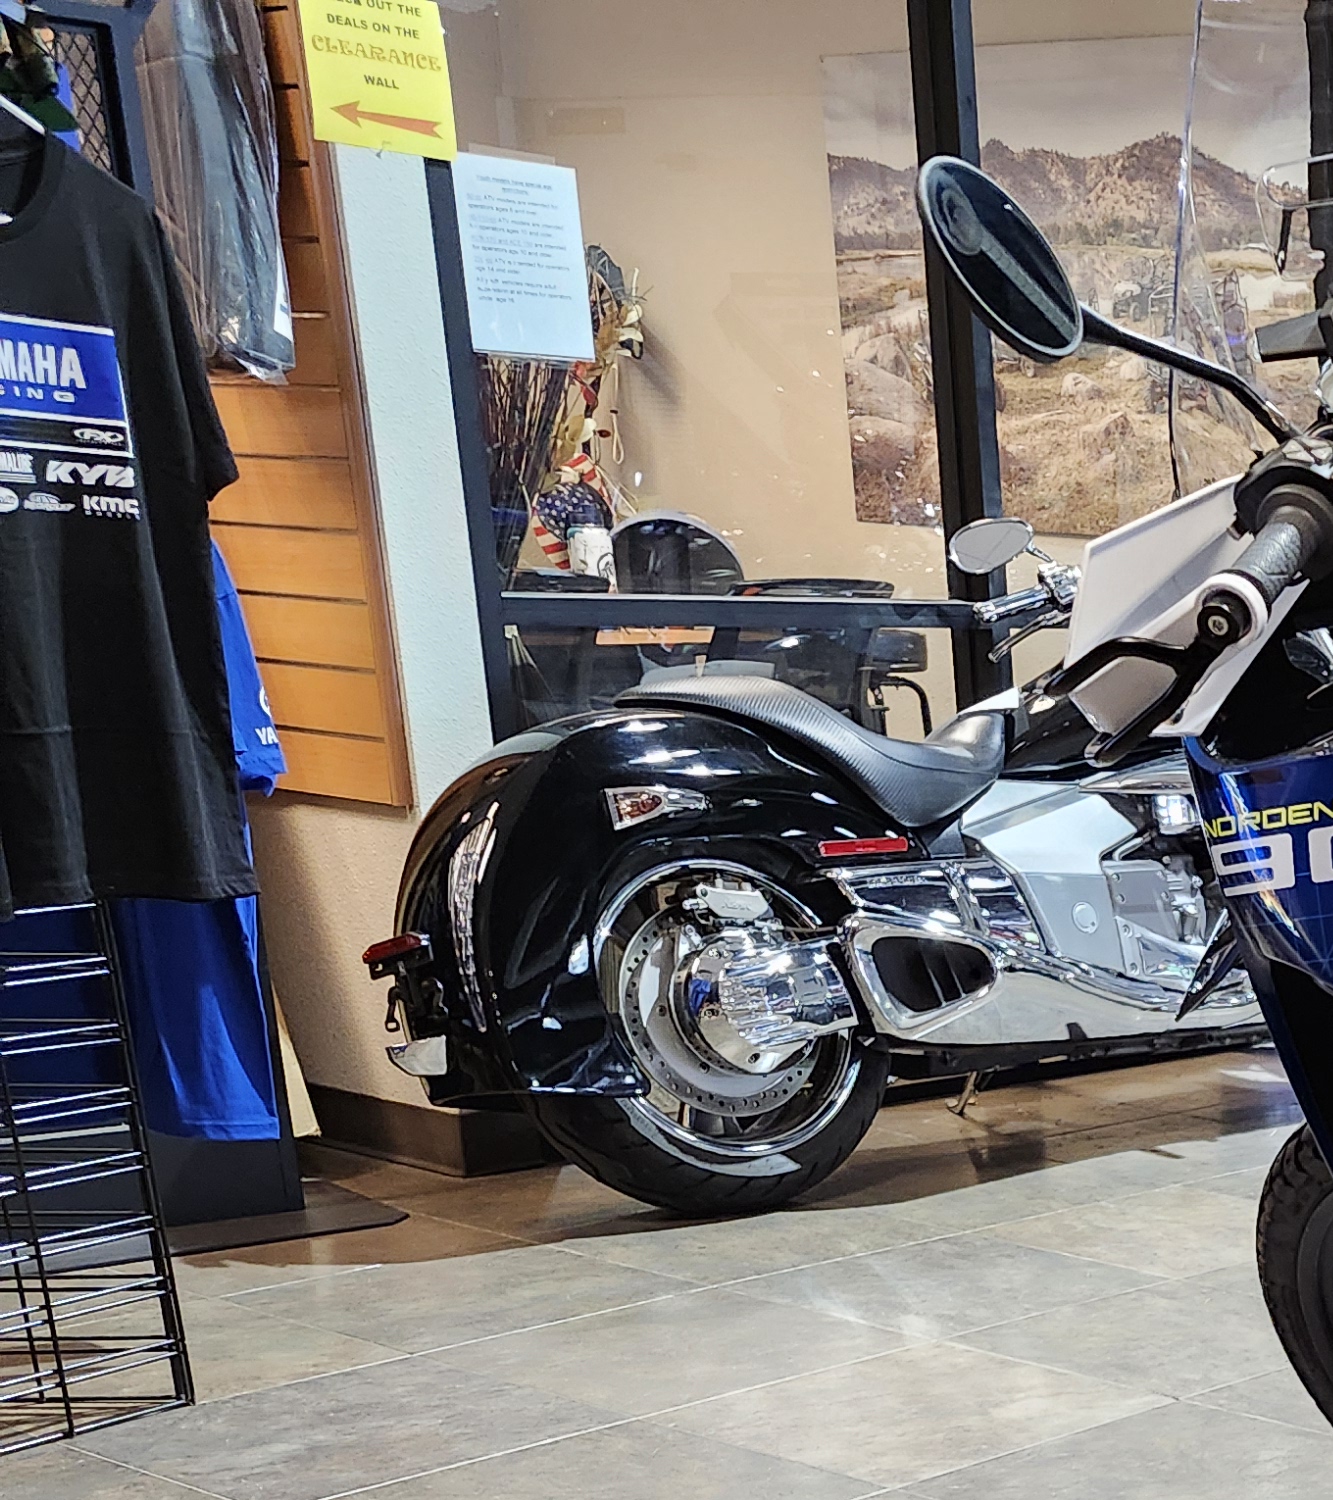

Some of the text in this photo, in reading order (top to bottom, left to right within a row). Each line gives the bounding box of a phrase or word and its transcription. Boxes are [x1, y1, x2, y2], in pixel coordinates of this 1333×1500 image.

[366, 0, 392, 12] OUT
[397, 4, 422, 18] THE
[326, 13, 420, 39] DEALS ON THE
[311, 34, 442, 72] CLEARANCE
[363, 74, 400, 90] WALL
[0, 338, 87, 389] MAHA
[46, 459, 135, 488] KYB
[254, 726, 279, 746] YA
